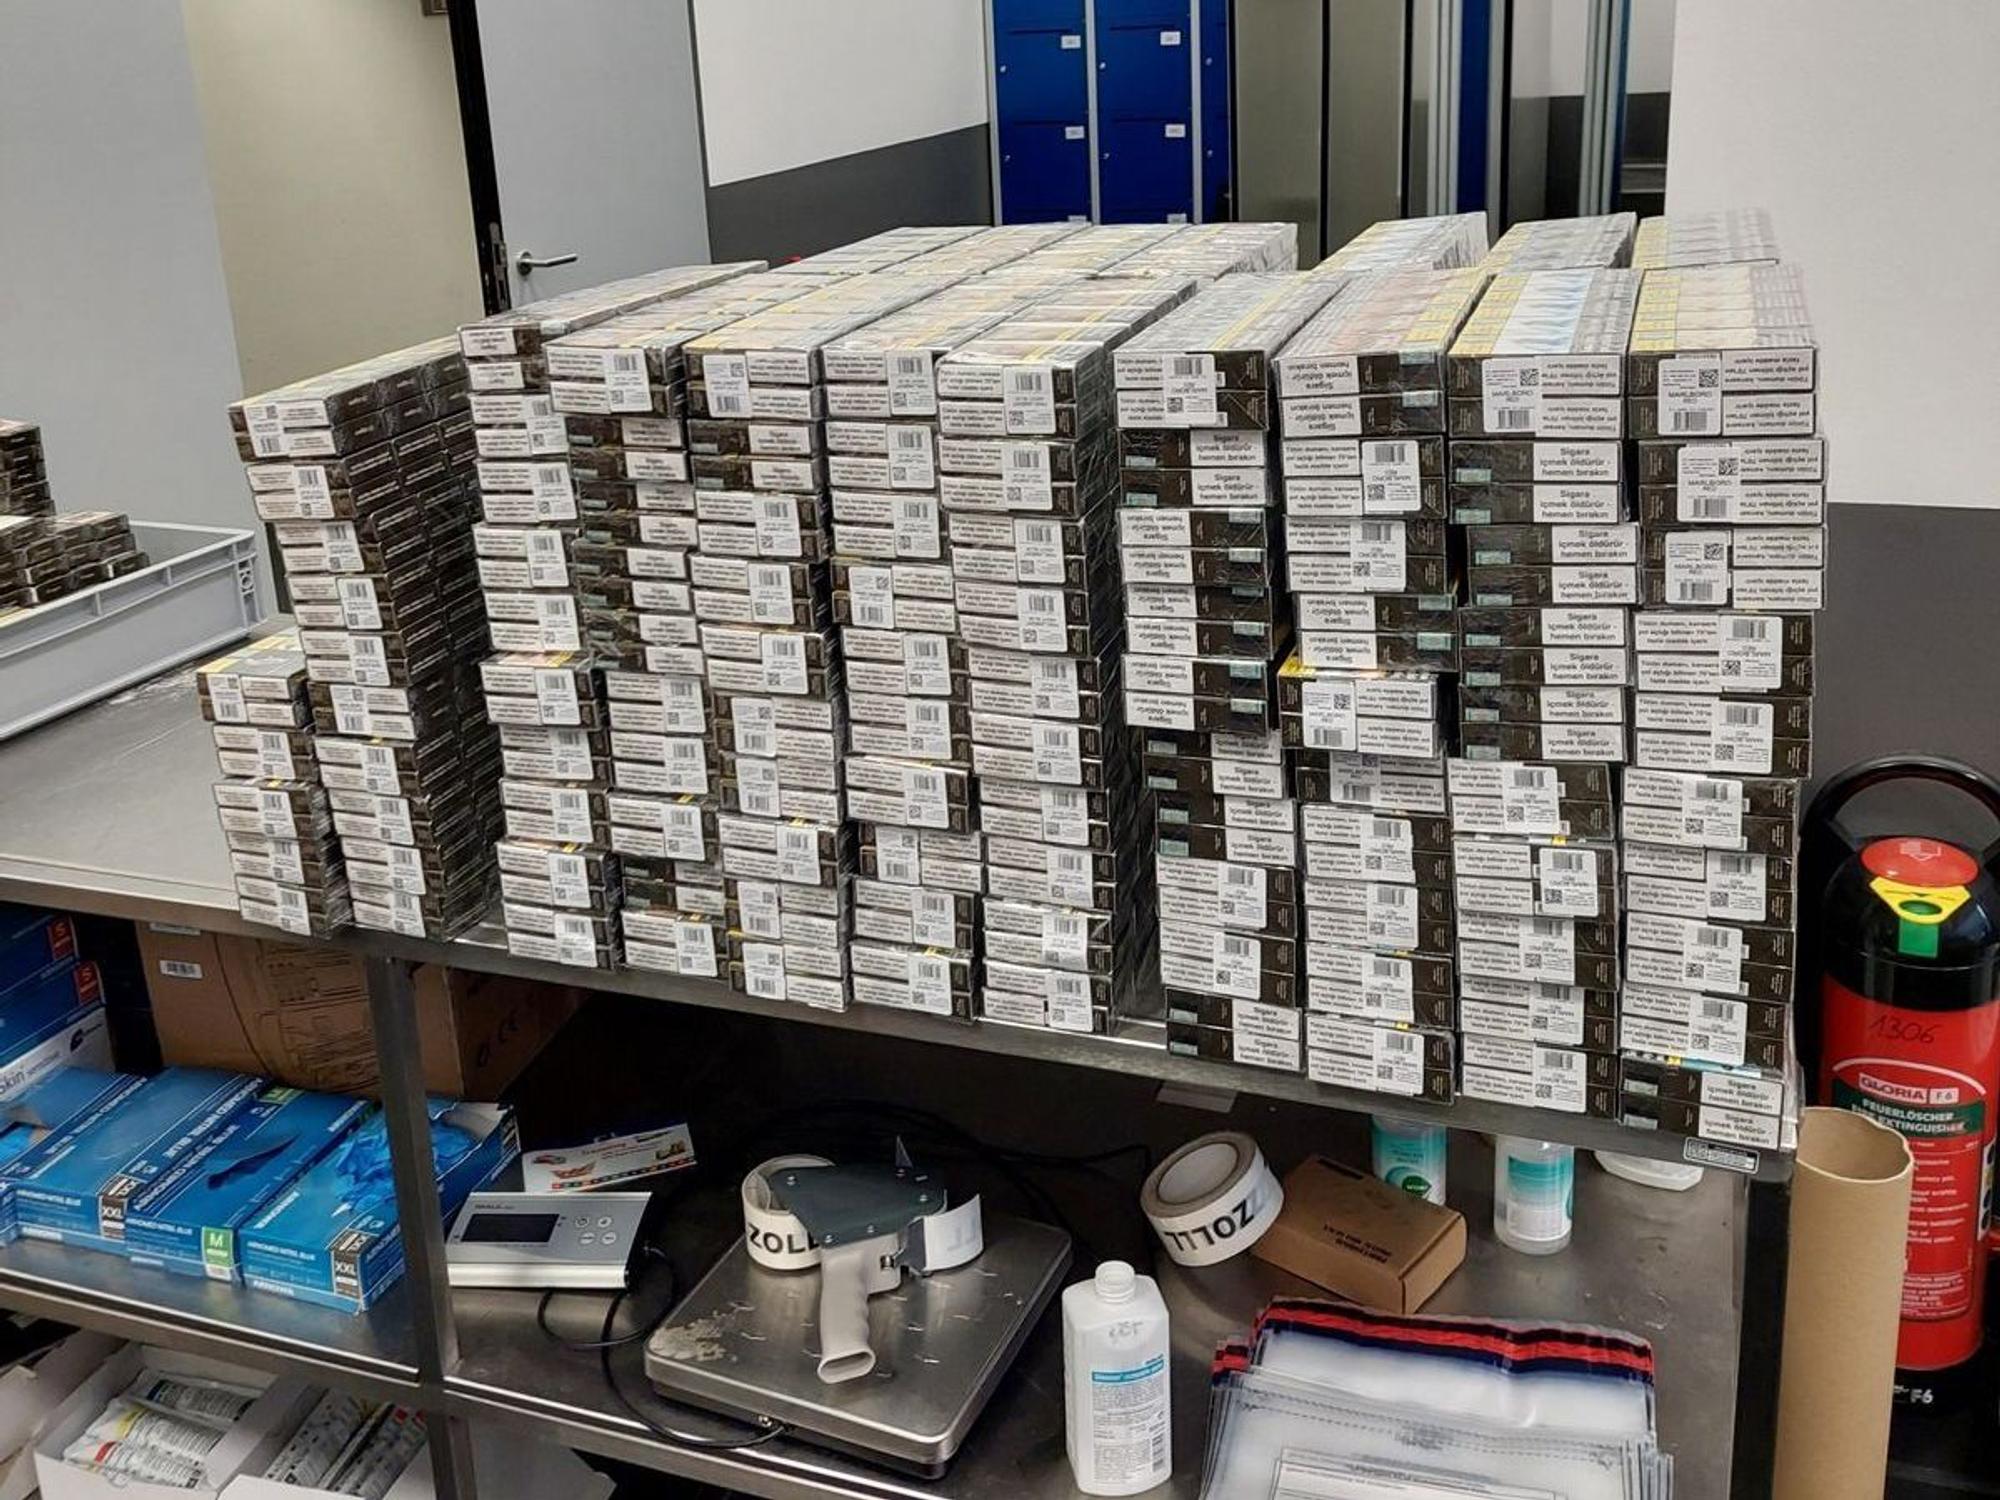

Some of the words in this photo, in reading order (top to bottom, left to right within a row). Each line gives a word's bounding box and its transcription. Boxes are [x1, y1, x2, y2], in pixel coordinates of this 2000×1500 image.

[1870, 1015, 1941, 1043] 1306
[1861, 1077, 1925, 1100] GLORIA
[1862, 1098, 1954, 1121] FEUERLÖSCHER
[209, 1232, 224, 1247] M
[335, 1261, 356, 1276] XXL
[1911, 1388, 1934, 1404] F6
